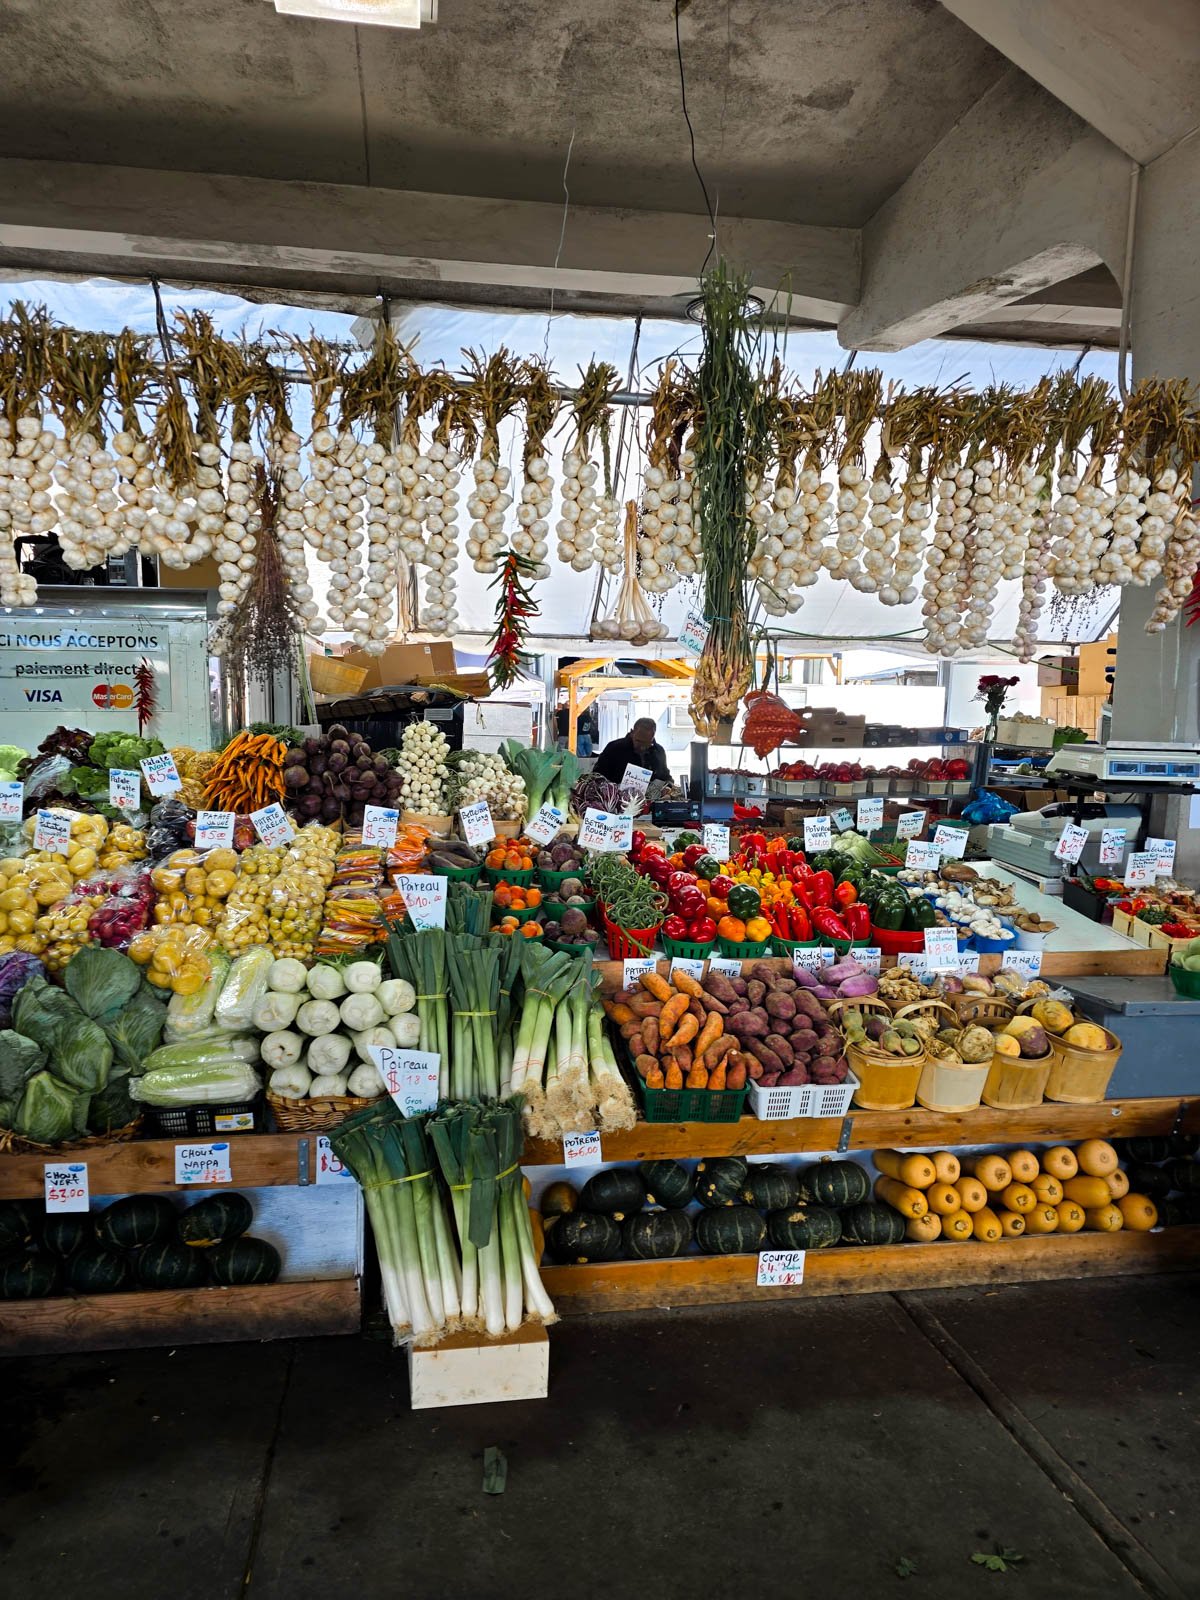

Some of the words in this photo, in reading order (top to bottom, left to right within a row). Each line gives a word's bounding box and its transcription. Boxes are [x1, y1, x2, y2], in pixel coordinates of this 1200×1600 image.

[685, 622, 705, 641] Frais
[16, 634, 62, 647] NOUS
[66, 635, 158, 648] ACCEPTONS
[15, 661, 90, 677] paiement
[93, 662, 138, 675] direct
[24, 689, 63, 703] VISA
[398, 876, 439, 892] Poireau
[795, 949, 821, 961] Radis
[380, 1047, 428, 1070] Poireau
[184, 1159, 219, 1170] NAPPA
[762, 1253, 800, 1267] Courge
